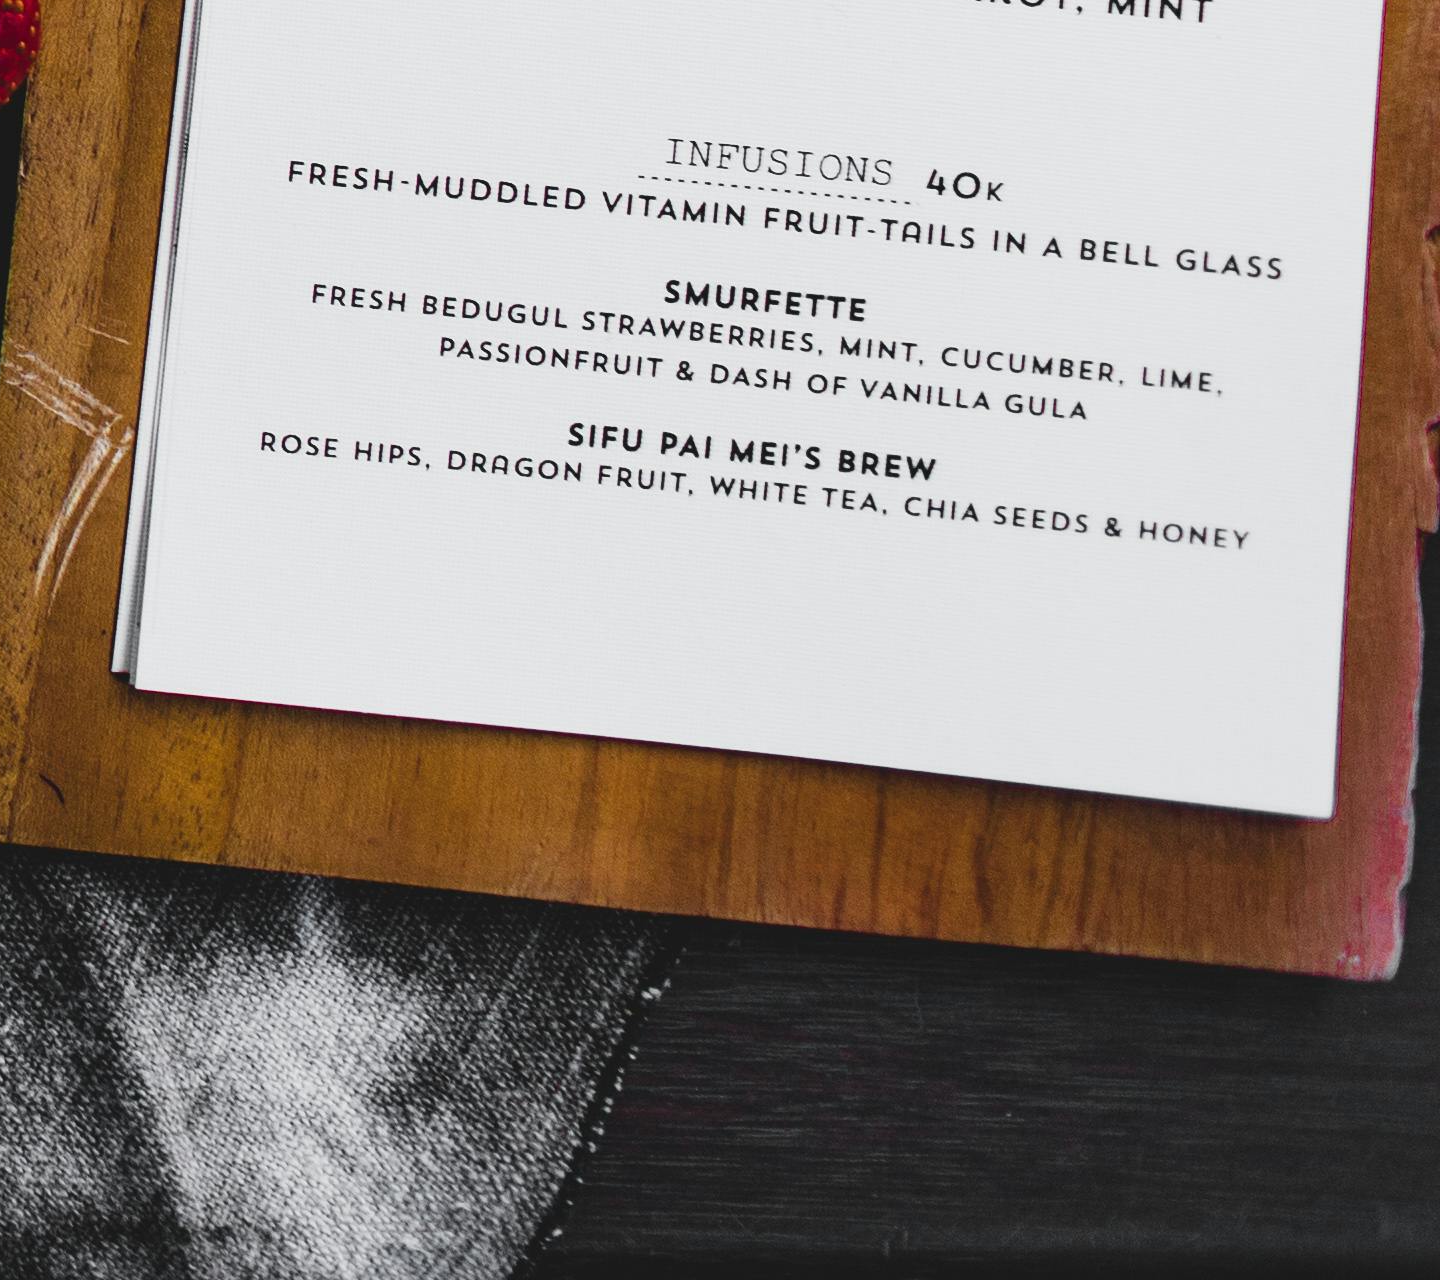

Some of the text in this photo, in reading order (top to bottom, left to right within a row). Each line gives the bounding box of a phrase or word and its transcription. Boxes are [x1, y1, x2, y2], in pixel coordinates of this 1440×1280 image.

[665, 138, 892, 186] INFUSIONS
[288, 160, 1282, 280] FRESH-MUDDLED VITAMIN FRUIT-TAILS IN A BELL GLASS
[312, 283, 1224, 398] FRESH BEDUGUL STRAWBERRIES, MINT, CUCUMBER, LIME,
[663, 279, 867, 323] SMURFETTE
[439, 336, 1087, 420] PASSIONFRUIT & DASH OF VANILLA GULA
[260, 431, 1249, 549] ROSE HIPS, DRAGON FRUIT, WHITE TEA, CHIA SEEDS & HONEY
[567, 422, 937, 481] SIFU PAI MEI'S BREW
